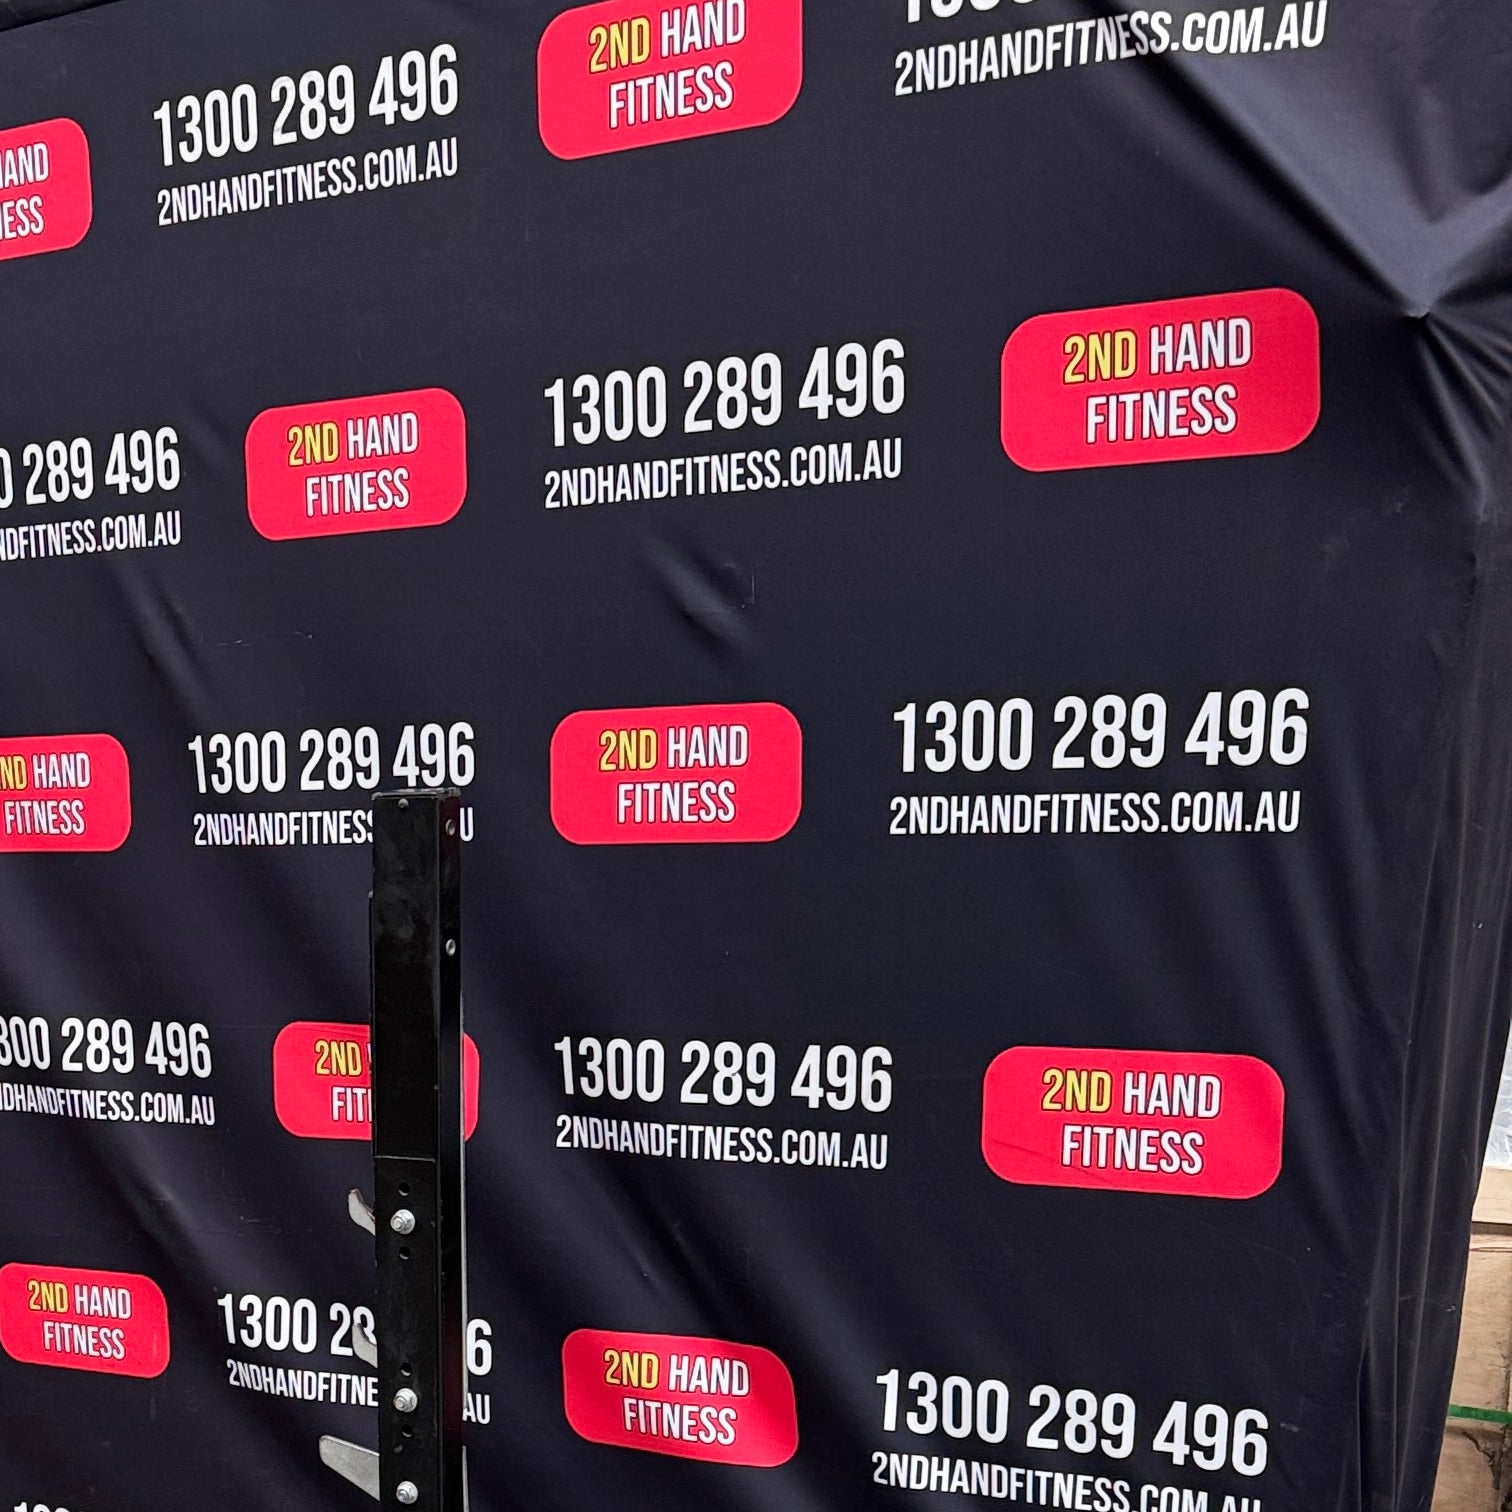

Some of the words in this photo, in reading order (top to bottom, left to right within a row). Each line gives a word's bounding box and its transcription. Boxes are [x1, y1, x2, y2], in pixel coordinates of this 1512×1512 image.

[589, 17, 650, 73] 2ND
[661, 0, 745, 57] HAND
[895, 0, 1328, 96] 2NDHANDFITNESS.COM.AU
[153, 83, 258, 167] 1300
[270, 64, 355, 146] 289
[368, 43, 458, 126] 496
[610, 61, 733, 128] FITNESS
[157, 136, 458, 226] 2NDHANDFITNESS.COM.AU
[1064, 330, 1136, 383] 2ND
[1150, 317, 1251, 374] HAND
[544, 366, 667, 447] 1300
[683, 352, 782, 434] 289
[798, 338, 905, 420] 496
[1087, 384, 1236, 443] FITNESS
[22, 437, 94, 505] 289
[104, 426, 180, 495] 496
[288, 422, 339, 466] 2ND
[347, 412, 418, 459] HAND
[306, 467, 409, 517] FITNESS
[544, 437, 902, 509] 2NDHANDFITNESS.COM.AU
[187, 730, 287, 794] 1300
[299, 726, 381, 791] 289
[392, 721, 475, 787] 496
[600, 729, 657, 771] 2ND
[668, 725, 748, 768] HAND
[893, 697, 1034, 773] 1300
[1052, 692, 1167, 769] 289
[1184, 687, 1310, 767] 496
[32, 752, 91, 789] HAND
[4, 799, 85, 835] FITNESS
[618, 780, 735, 823] FITNESS
[889, 790, 1301, 835] 2NDHANDFITNESS.COM.AU
[61, 1017, 135, 1074] 289
[144, 1021, 212, 1079] 496
[315, 1040, 362, 1076] 2ND
[554, 1036, 665, 1103] 1300
[680, 1040, 776, 1107] 289
[790, 1044, 893, 1113] 496
[1042, 1068, 1111, 1112] 2ND
[1123, 1071, 1221, 1118] HAND
[555, 1114, 888, 1170] 2NDHANDFITNESS.COM.AU
[1062, 1125, 1203, 1175] FITNESS
[28, 1280, 69, 1313] 2ND
[74, 1284, 131, 1319] HAND
[217, 1293, 317, 1354] 1300
[43, 1320, 125, 1360] FITNESS
[604, 1349, 659, 1389] 2ND
[668, 1354, 749, 1396] HAND
[623, 1397, 737, 1445] FITNESS
[876, 1368, 1010, 1444] 1300
[1026, 1384, 1136, 1459] 289
[1152, 1400, 1269, 1477] 496
